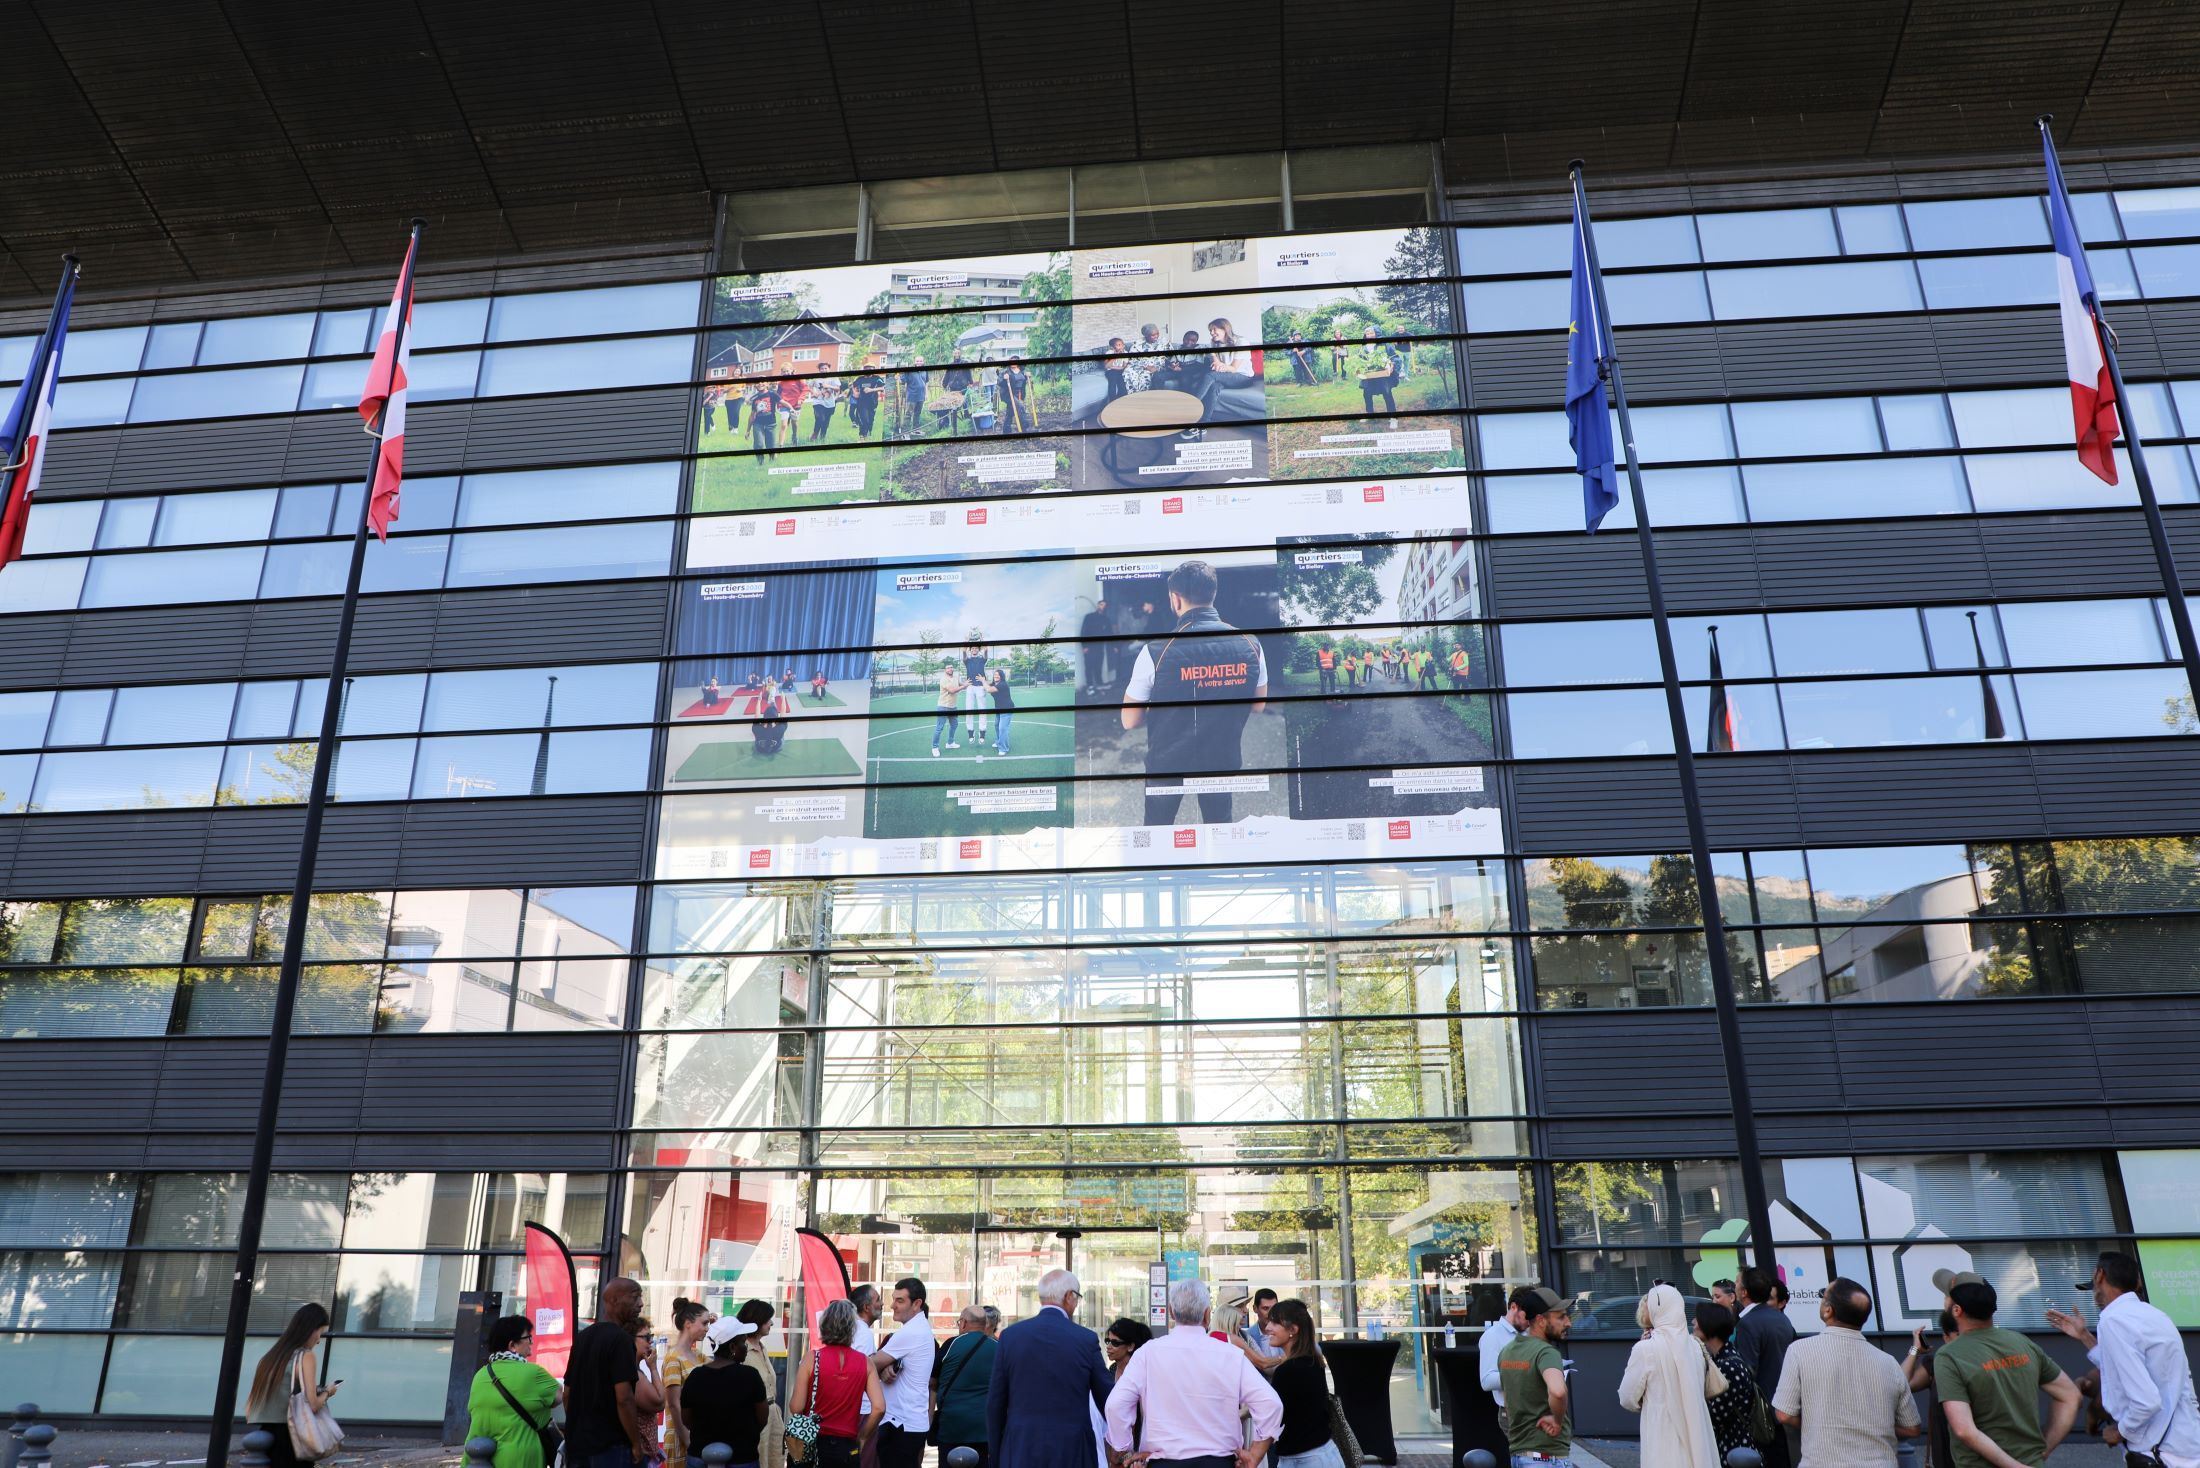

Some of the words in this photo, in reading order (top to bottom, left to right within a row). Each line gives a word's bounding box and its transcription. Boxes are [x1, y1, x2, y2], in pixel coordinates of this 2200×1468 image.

[1181, 663, 1247, 680] MEDIATEUR
[1224, 678, 1247, 686] service
[1789, 1289, 1820, 1298] Habita
